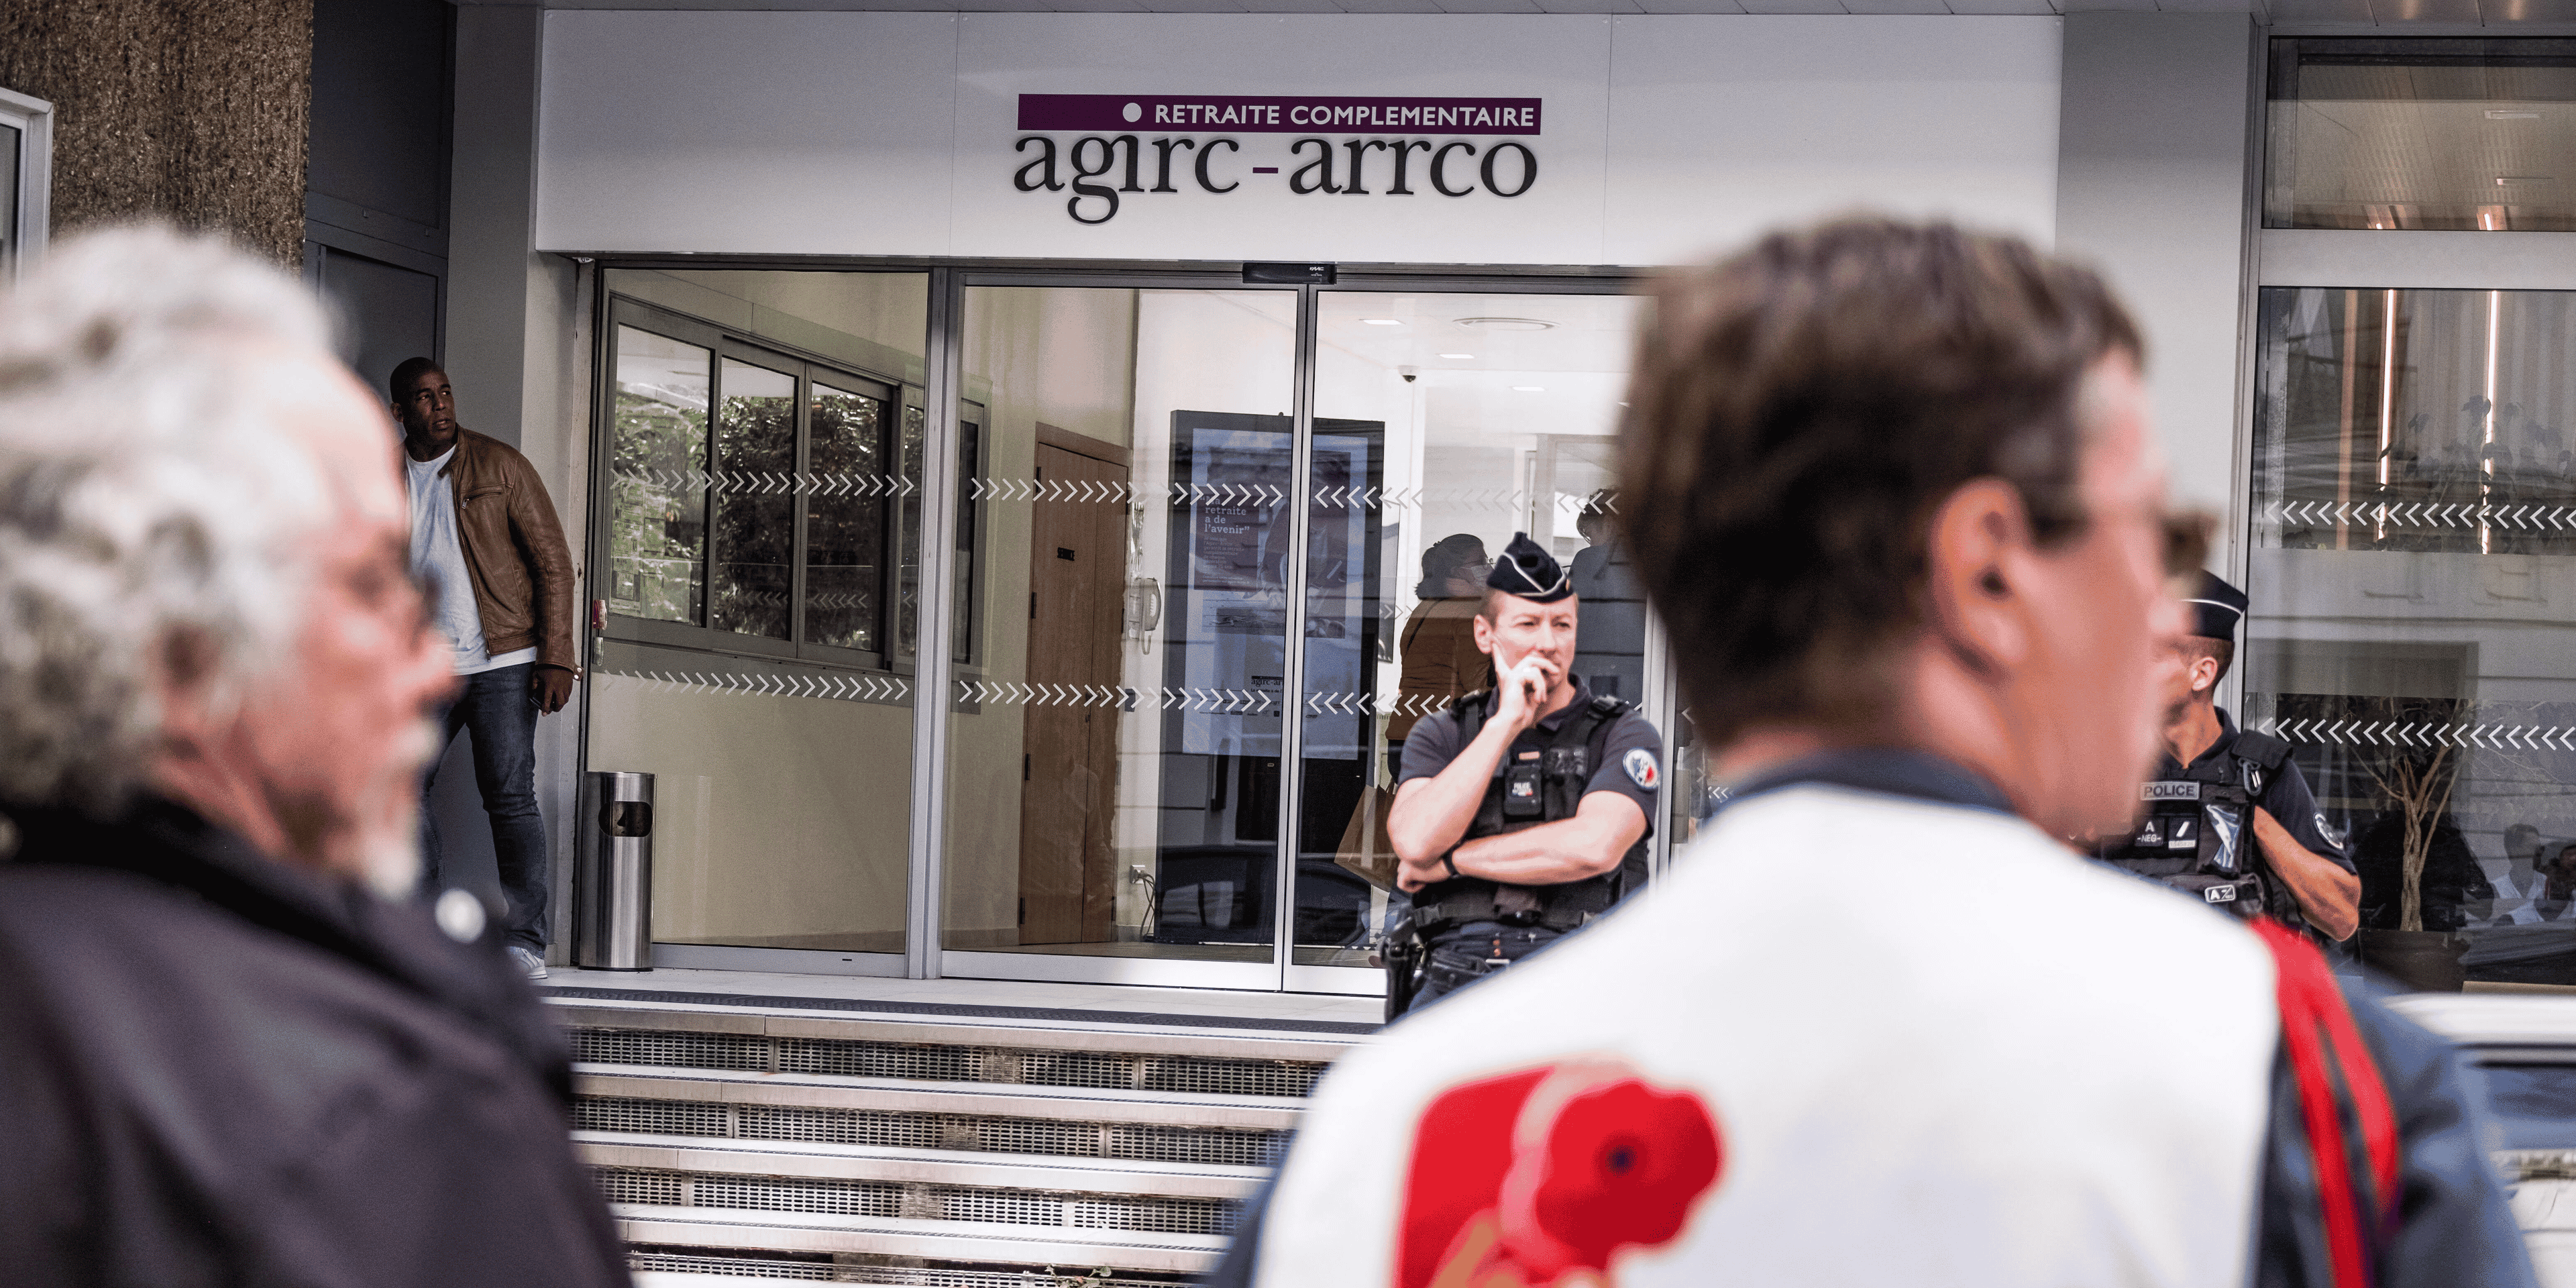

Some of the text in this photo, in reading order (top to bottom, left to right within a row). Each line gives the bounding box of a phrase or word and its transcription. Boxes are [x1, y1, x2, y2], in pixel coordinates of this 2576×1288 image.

[1155, 105, 1534, 127] RETRAITE COMPLEMENTAIRE
[1013, 134, 1538, 225] agirc-arrco
[1205, 506, 1246, 515] retraite
[1214, 515, 1226, 524] de
[2144, 785, 2194, 797] POLICE
[2145, 821, 2155, 832] A
